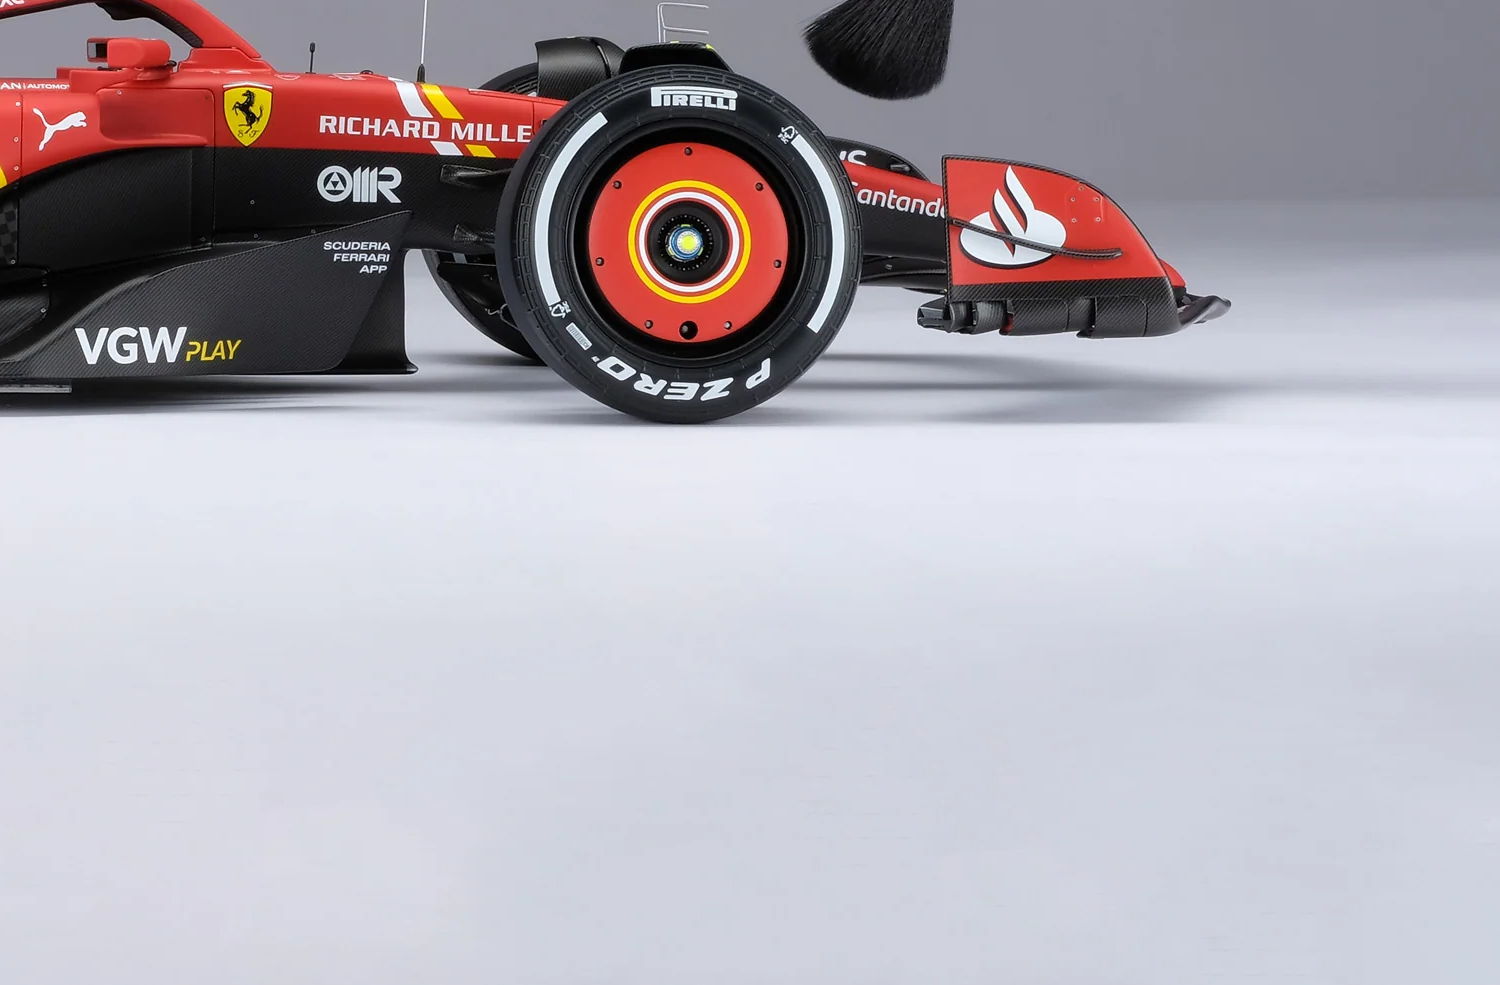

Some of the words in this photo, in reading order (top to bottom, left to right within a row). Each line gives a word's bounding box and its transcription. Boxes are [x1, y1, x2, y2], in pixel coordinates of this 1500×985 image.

[650, 86, 738, 111] PIRELLI
[319, 115, 441, 140] RICHARD
[451, 122, 533, 143] MILLE
[851, 181, 946, 219] antand
[323, 241, 391, 251] SCUDERIA
[333, 253, 391, 263] FERRARI
[359, 265, 388, 274] APP
[74, 326, 188, 365] VGW
[185, 339, 242, 362] PLAY
[597, 356, 734, 401] ZERO
[745, 357, 771, 389] P
